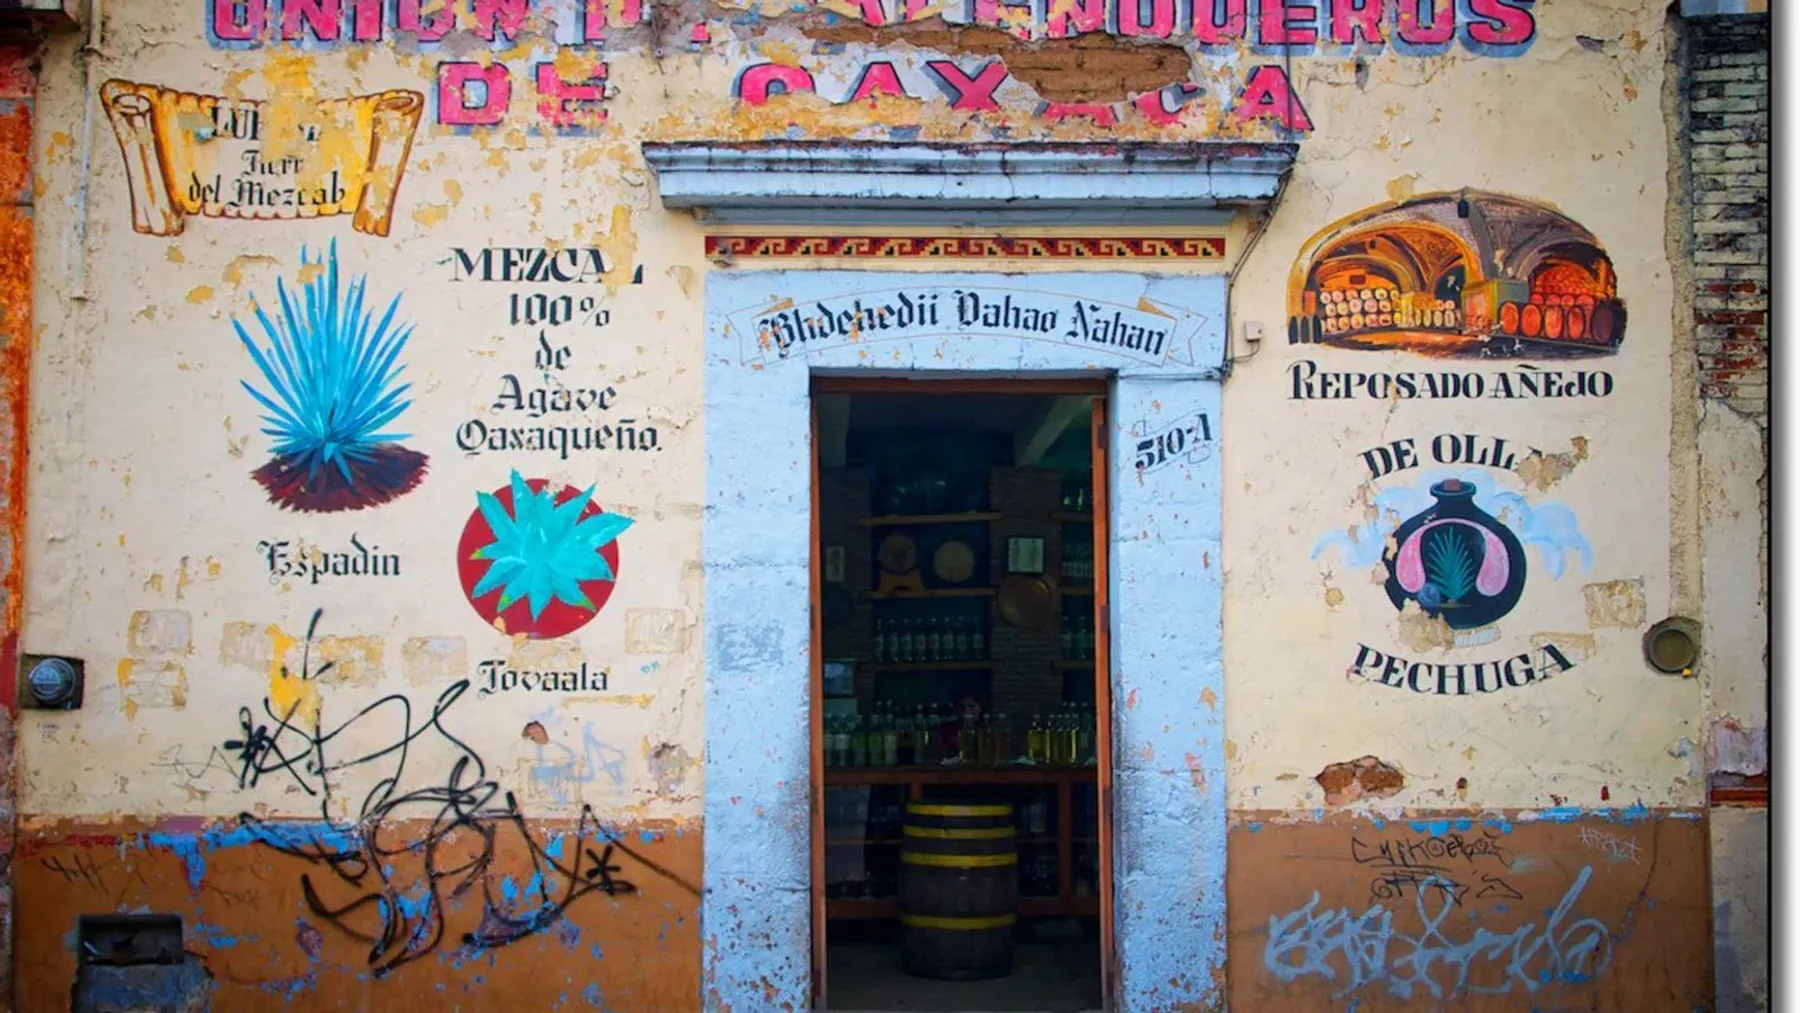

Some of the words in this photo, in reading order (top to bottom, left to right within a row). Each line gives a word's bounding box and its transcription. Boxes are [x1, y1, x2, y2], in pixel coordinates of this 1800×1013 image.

[434, 60, 610, 128] DE
[188, 171, 222, 204] del
[508, 293, 611, 327] 100%
[535, 328, 573, 372] de
[490, 374, 619, 419] Agave
[1286, 359, 1485, 401] REPOSADO
[1490, 363, 1614, 400] AÑEJO
[1357, 438, 1420, 480] DE
[255, 532, 401, 586] Espadin
[1350, 642, 1577, 696] PECHUGA
